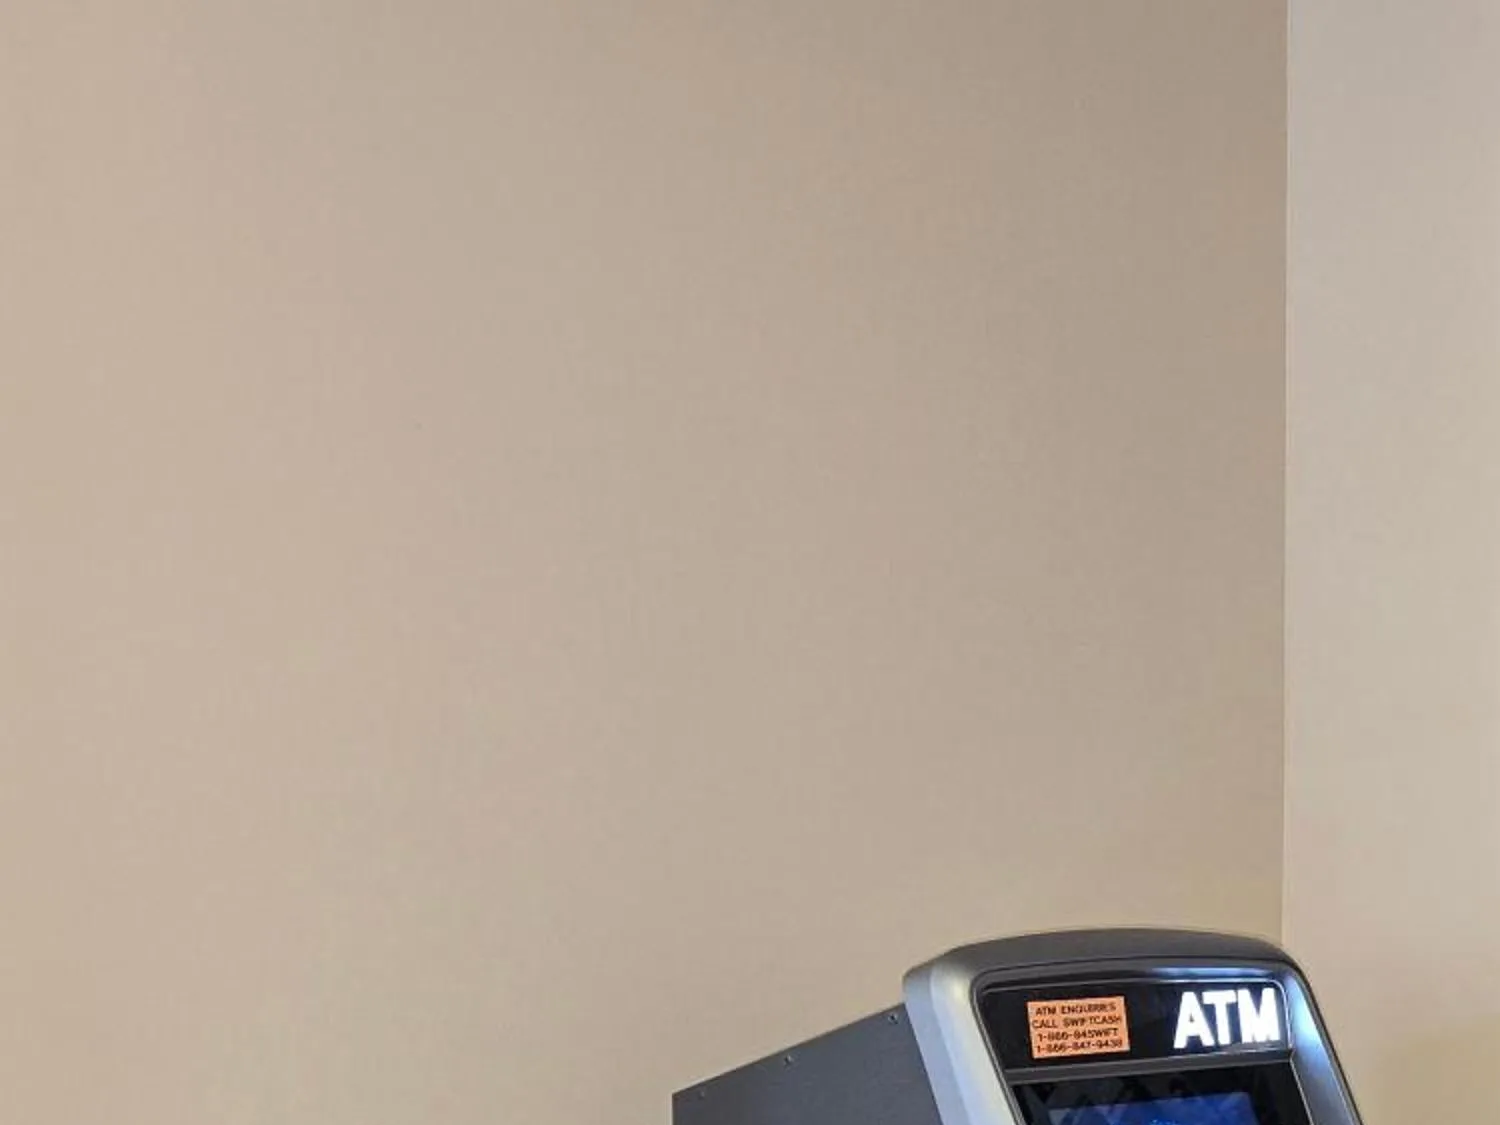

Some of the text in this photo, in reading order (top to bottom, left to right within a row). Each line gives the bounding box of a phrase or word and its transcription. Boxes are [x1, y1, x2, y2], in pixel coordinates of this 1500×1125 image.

[1035, 1005, 1057, 1016] ATM
[1174, 986, 1281, 1049] ATM
[1032, 1018, 1058, 1029] CALL
